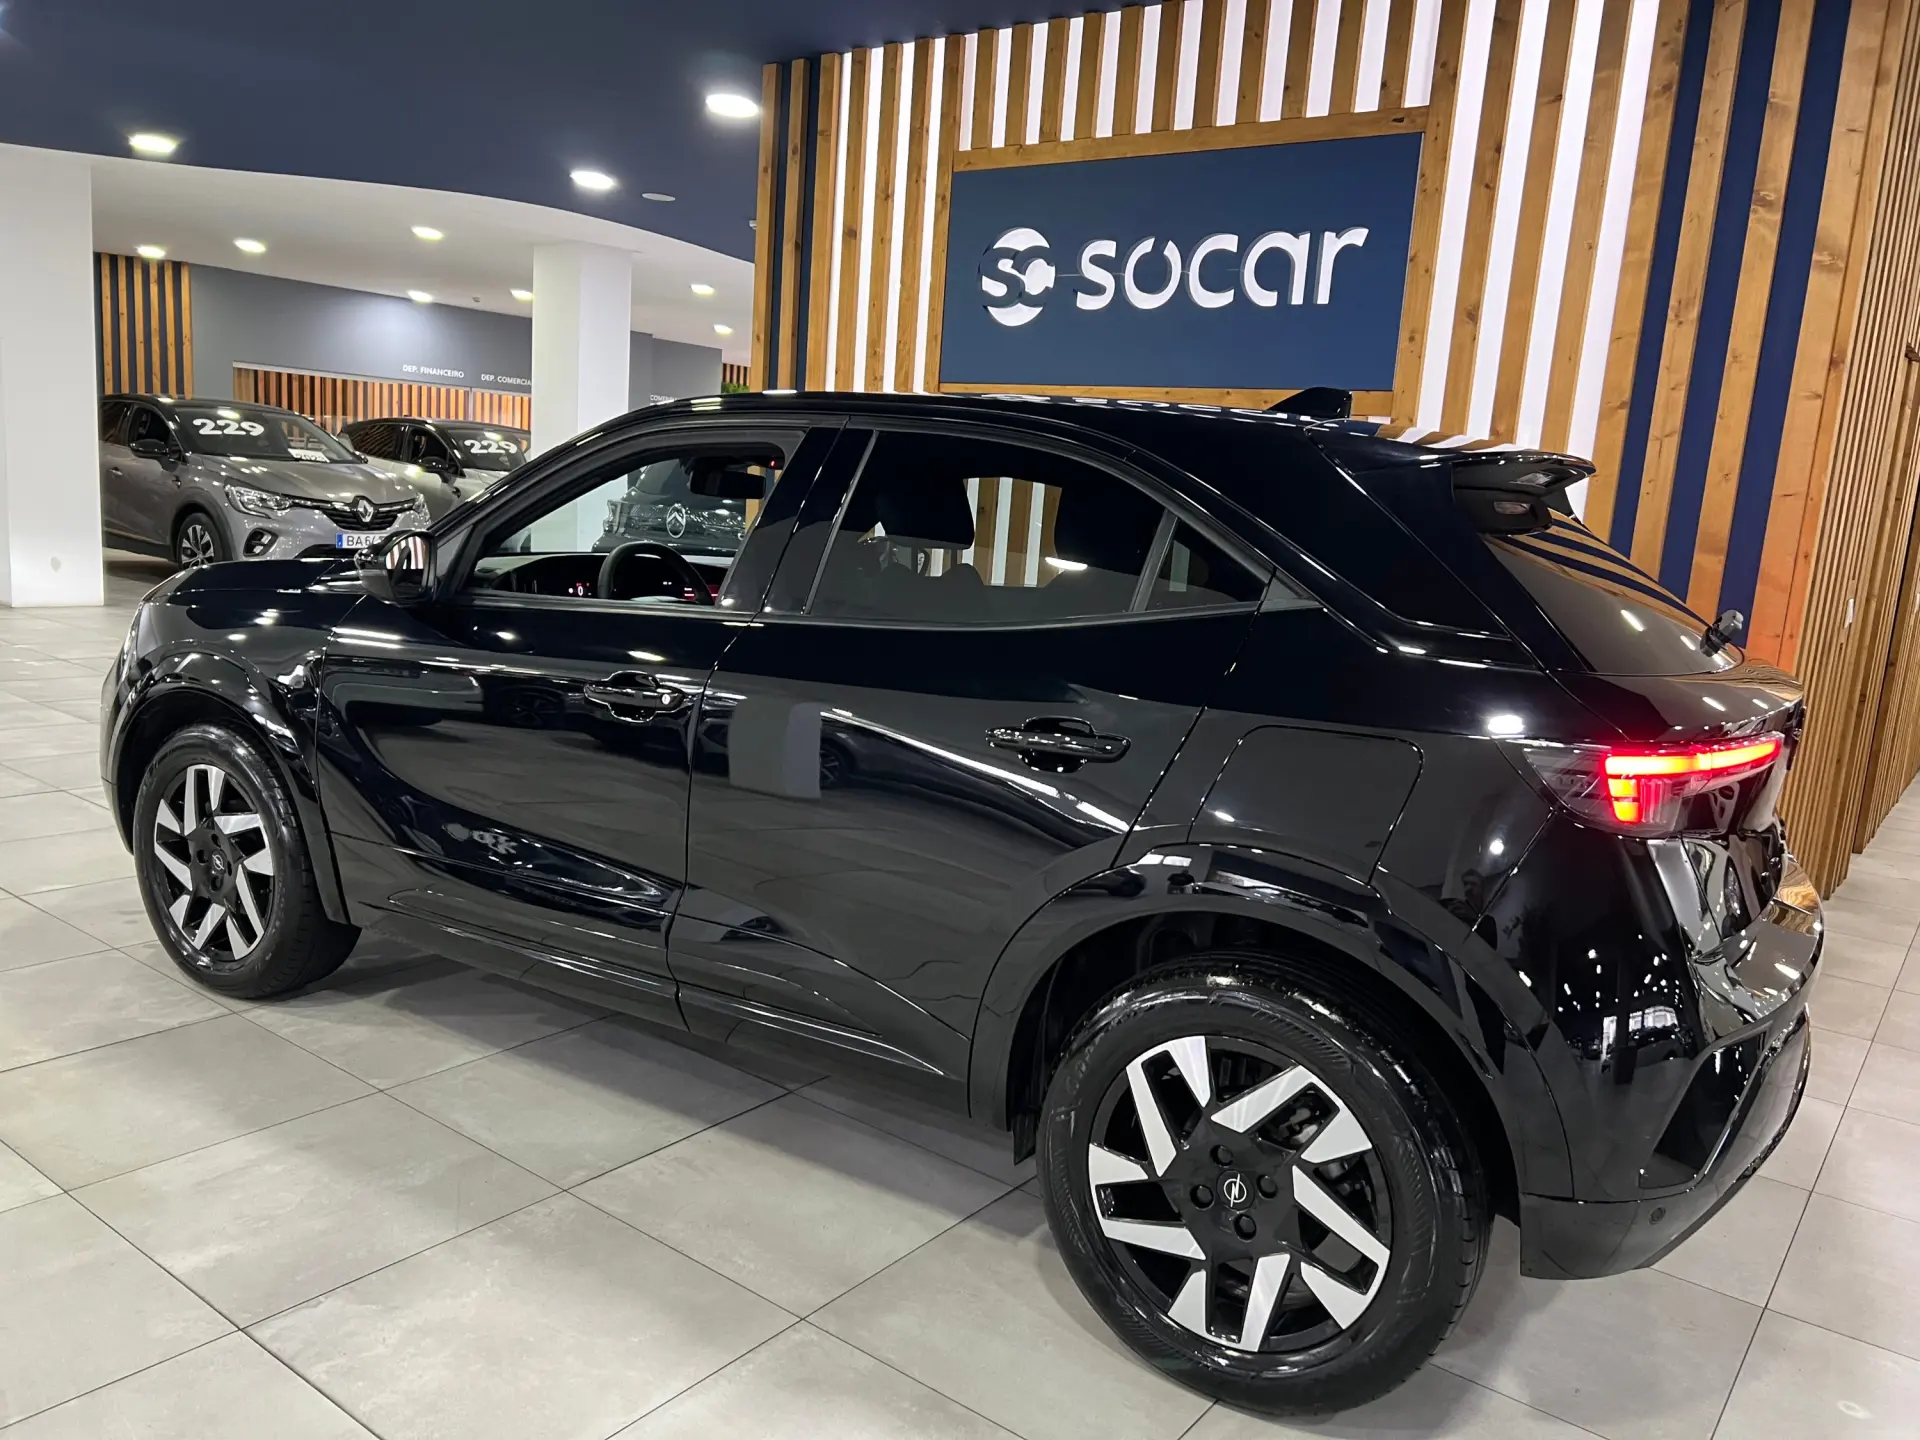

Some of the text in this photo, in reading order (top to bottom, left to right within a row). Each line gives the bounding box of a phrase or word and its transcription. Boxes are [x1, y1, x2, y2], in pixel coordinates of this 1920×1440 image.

[1073, 226, 1369, 311] socar
[402, 364, 465, 379] DEP. FINANCEIRO
[481, 373, 495, 382] DEP.
[192, 418, 265, 436] 229
[463, 439, 518, 454] 229
